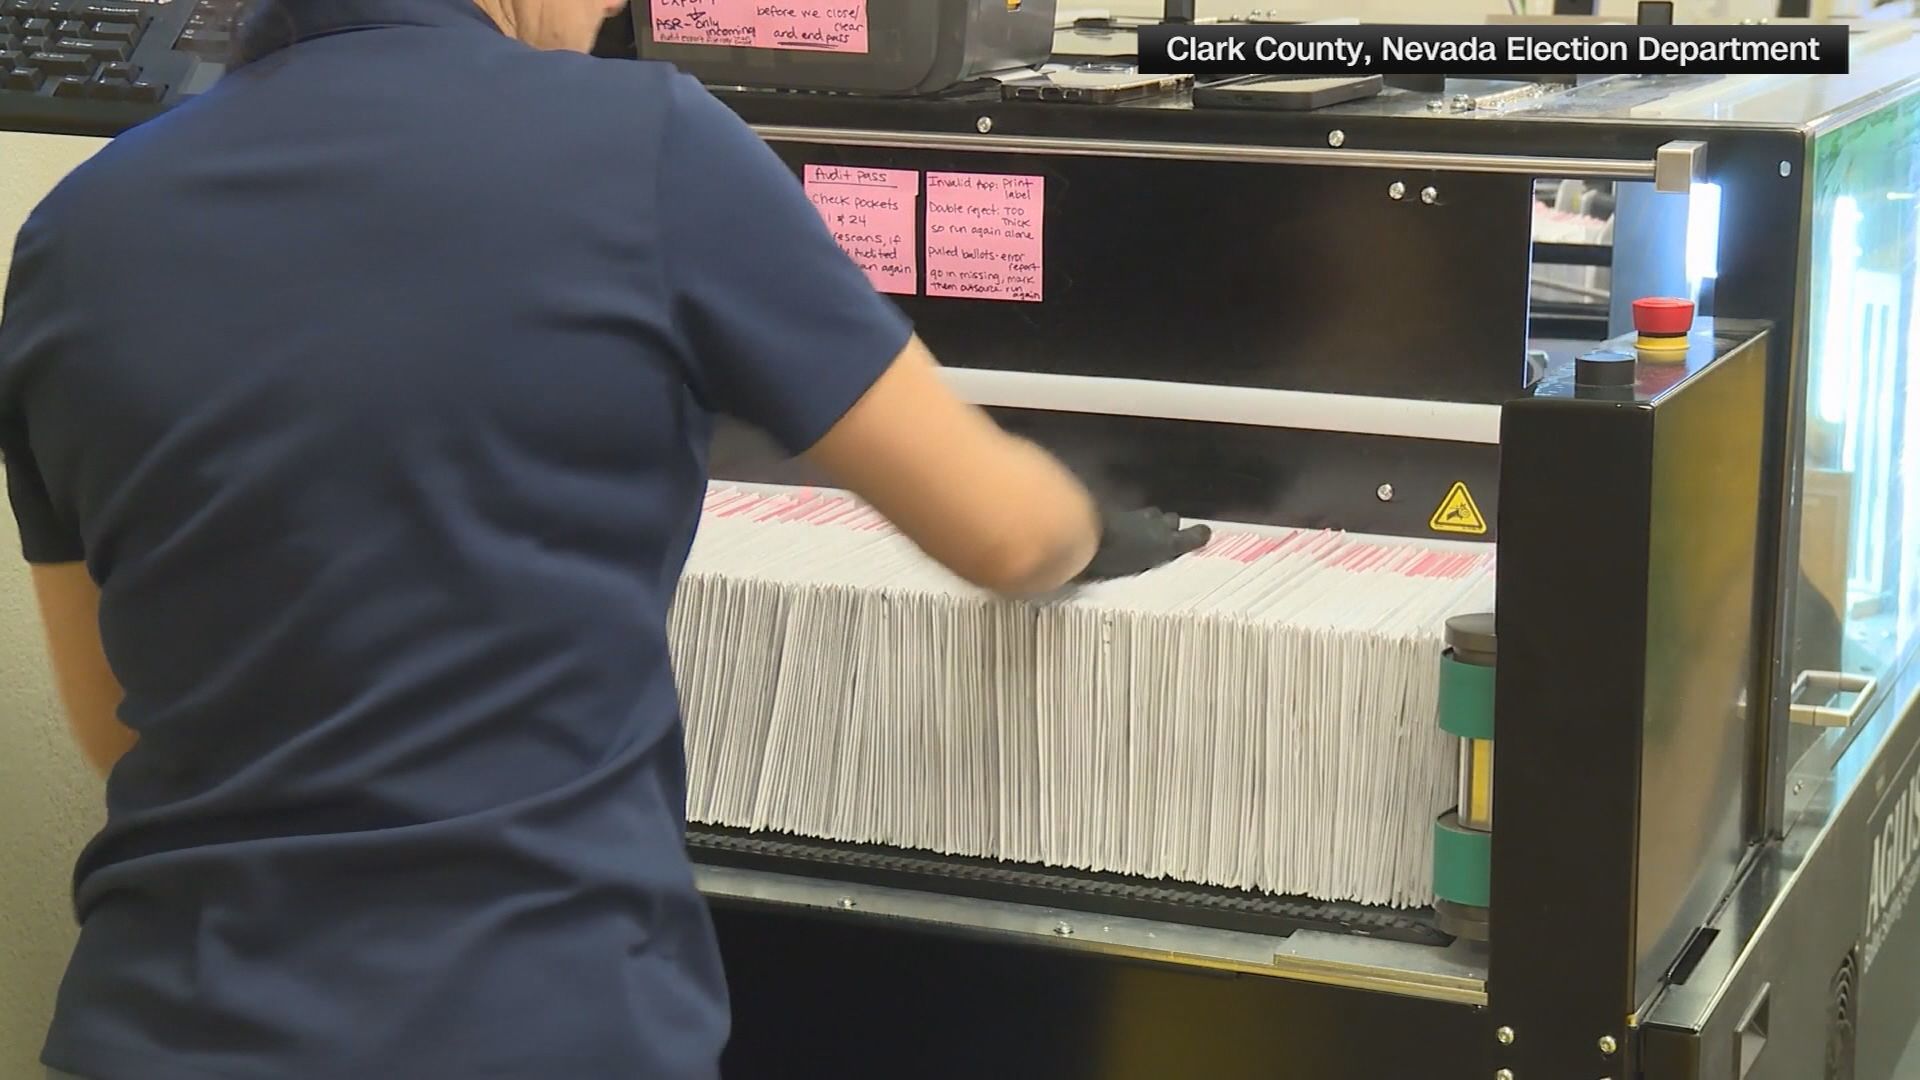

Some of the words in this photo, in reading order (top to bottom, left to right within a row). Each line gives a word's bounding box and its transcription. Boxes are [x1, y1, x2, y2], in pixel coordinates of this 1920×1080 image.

[757, 5, 796, 18] before
[801, 9, 820, 18] we
[695, 17, 719, 29] only
[834, 22, 864, 32] clear
[706, 26, 756, 37] incoming
[773, 26, 798, 39] and
[801, 27, 823, 40] end
[825, 33, 850, 44] pass
[815, 167, 851, 180] Audit
[928, 175, 972, 188] Invalid
[1004, 189, 1031, 200] label
[855, 197, 899, 210] pockets
[929, 201, 963, 213] Double
[849, 215, 867, 227] 24
[931, 224, 945, 233] so
[949, 225, 967, 233] run
[971, 227, 1001, 238] again
[1005, 230, 1035, 240] alone
[881, 264, 912, 276] again
[1008, 262, 1040, 272] report
[930, 269, 943, 280] go
[946, 270, 956, 278] in
[1007, 275, 1035, 284] mark
[931, 282, 957, 291] them
[1006, 285, 1023, 293] run
[1012, 290, 1041, 300] again
